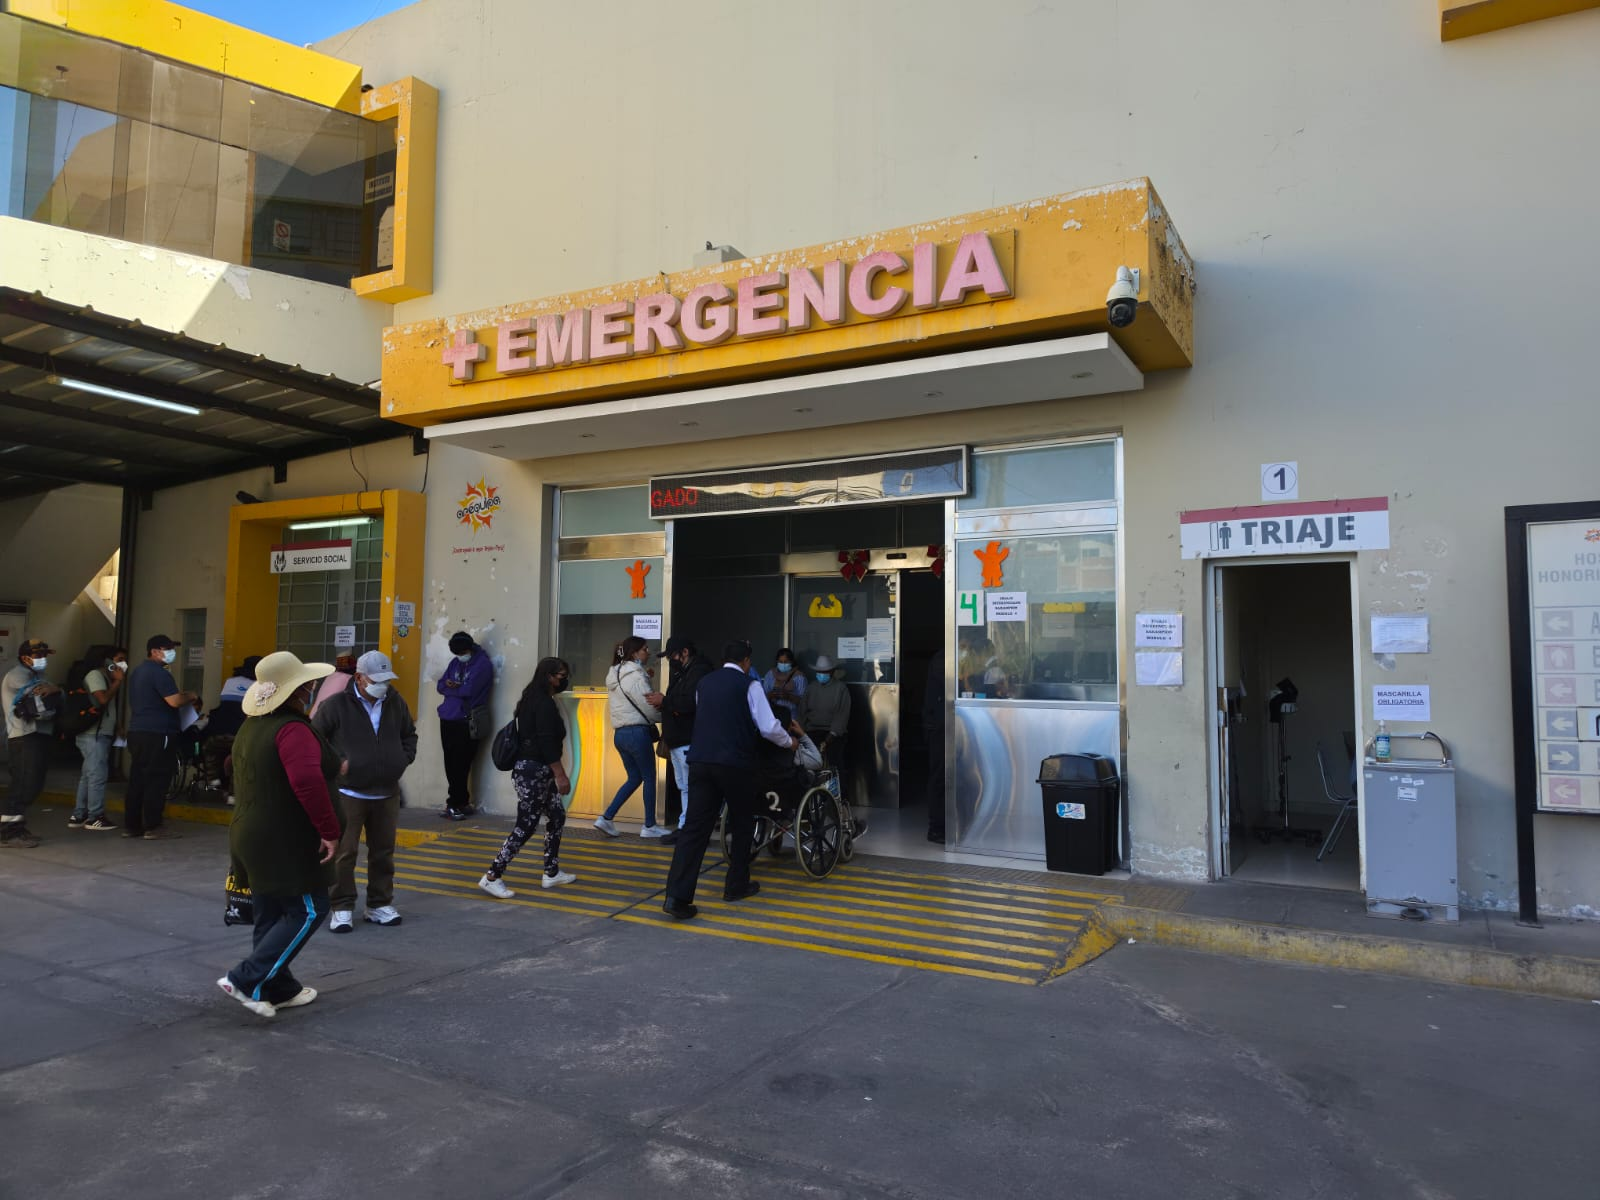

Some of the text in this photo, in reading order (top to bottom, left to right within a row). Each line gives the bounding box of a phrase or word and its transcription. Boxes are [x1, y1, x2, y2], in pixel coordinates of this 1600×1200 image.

[496, 231, 1011, 375] EMERGENCIA
[1273, 467, 1286, 491] 1
[651, 487, 697, 508] GADO
[1241, 515, 1356, 549] TRIAJE
[293, 554, 347, 565] SERVICIO SOCIAL
[1574, 552, 1600, 566] HO
[960, 593, 977, 625] 4
[765, 791, 782, 812] 2
